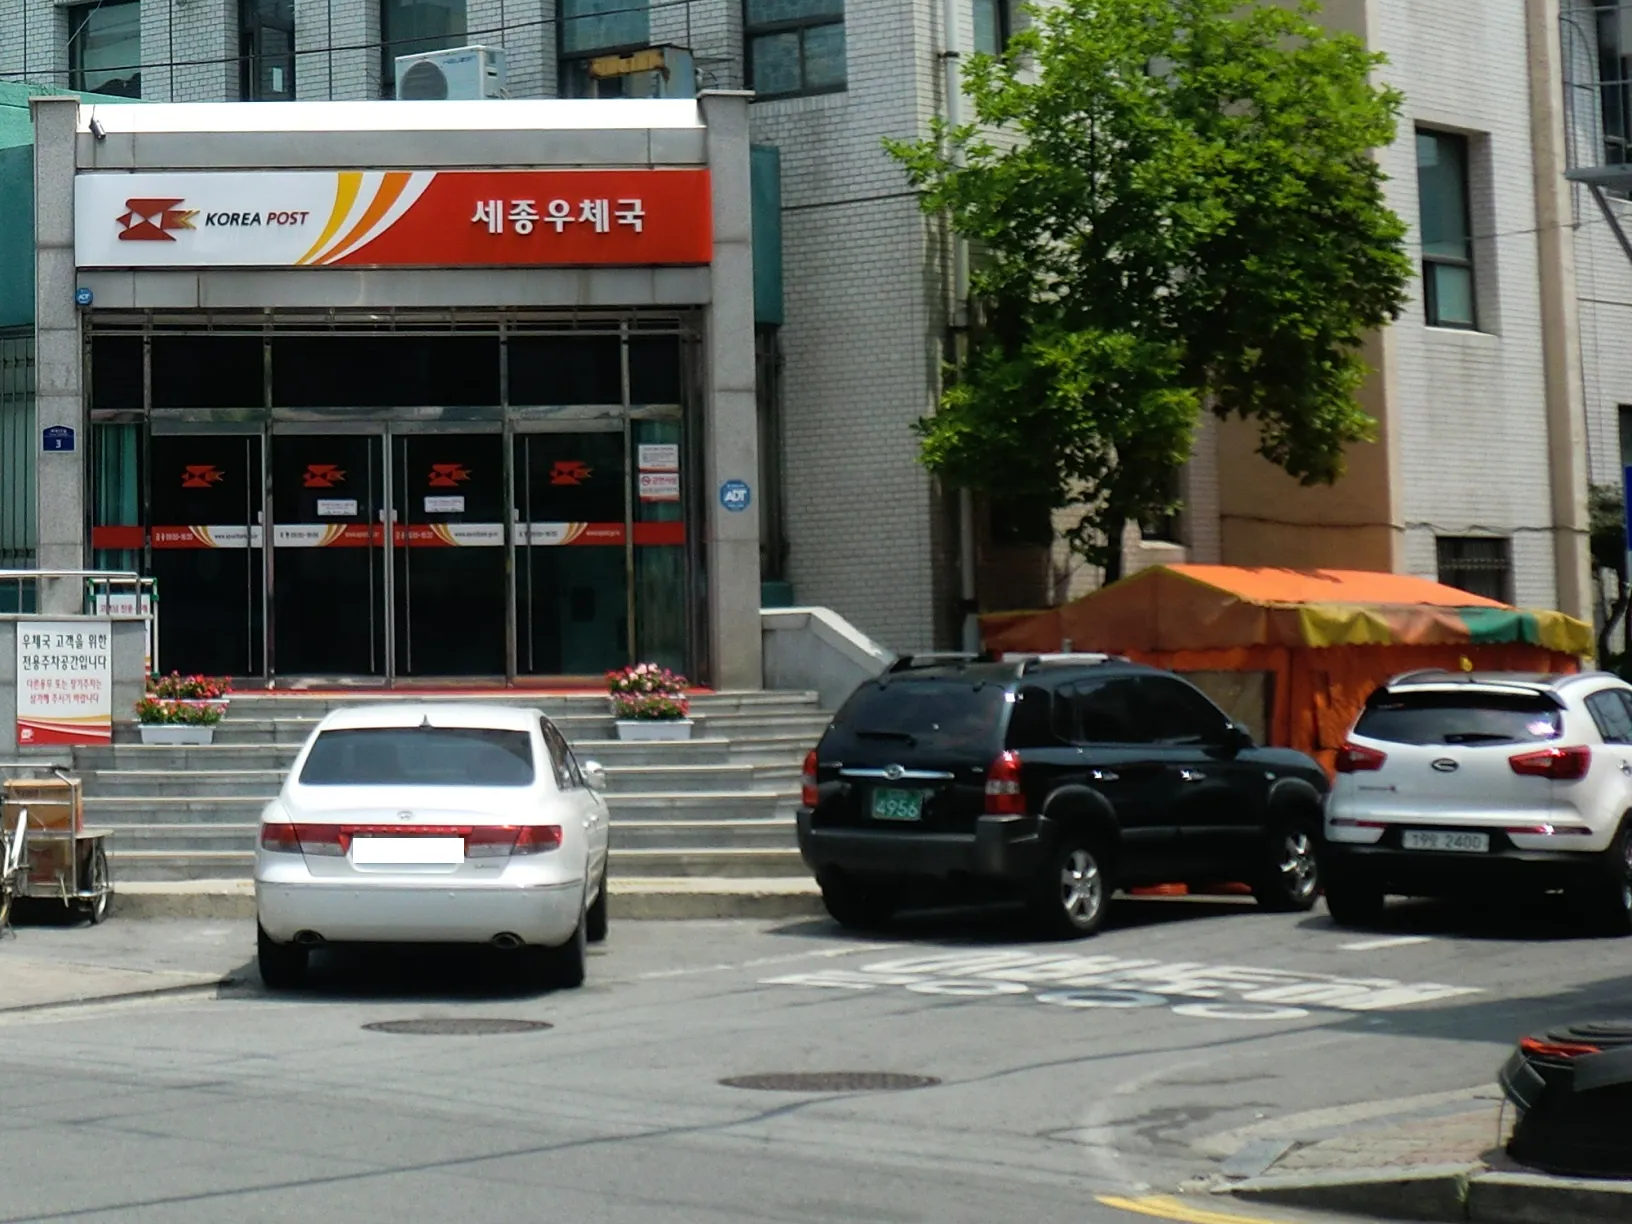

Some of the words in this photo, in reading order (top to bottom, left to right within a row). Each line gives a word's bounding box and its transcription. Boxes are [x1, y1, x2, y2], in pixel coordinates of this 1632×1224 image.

[205, 211, 262, 227] KOREA
[265, 211, 310, 227] POST
[470, 198, 647, 235] 세종우체국
[724, 489, 747, 502] ADT
[22, 634, 51, 650] 우체국
[55, 633, 84, 650] 고객을
[88, 633, 107, 650] 위한
[22, 655, 107, 671] 전용주차공간입니다
[875, 799, 919, 818] 4956
[1445, 834, 1483, 850] 2400
